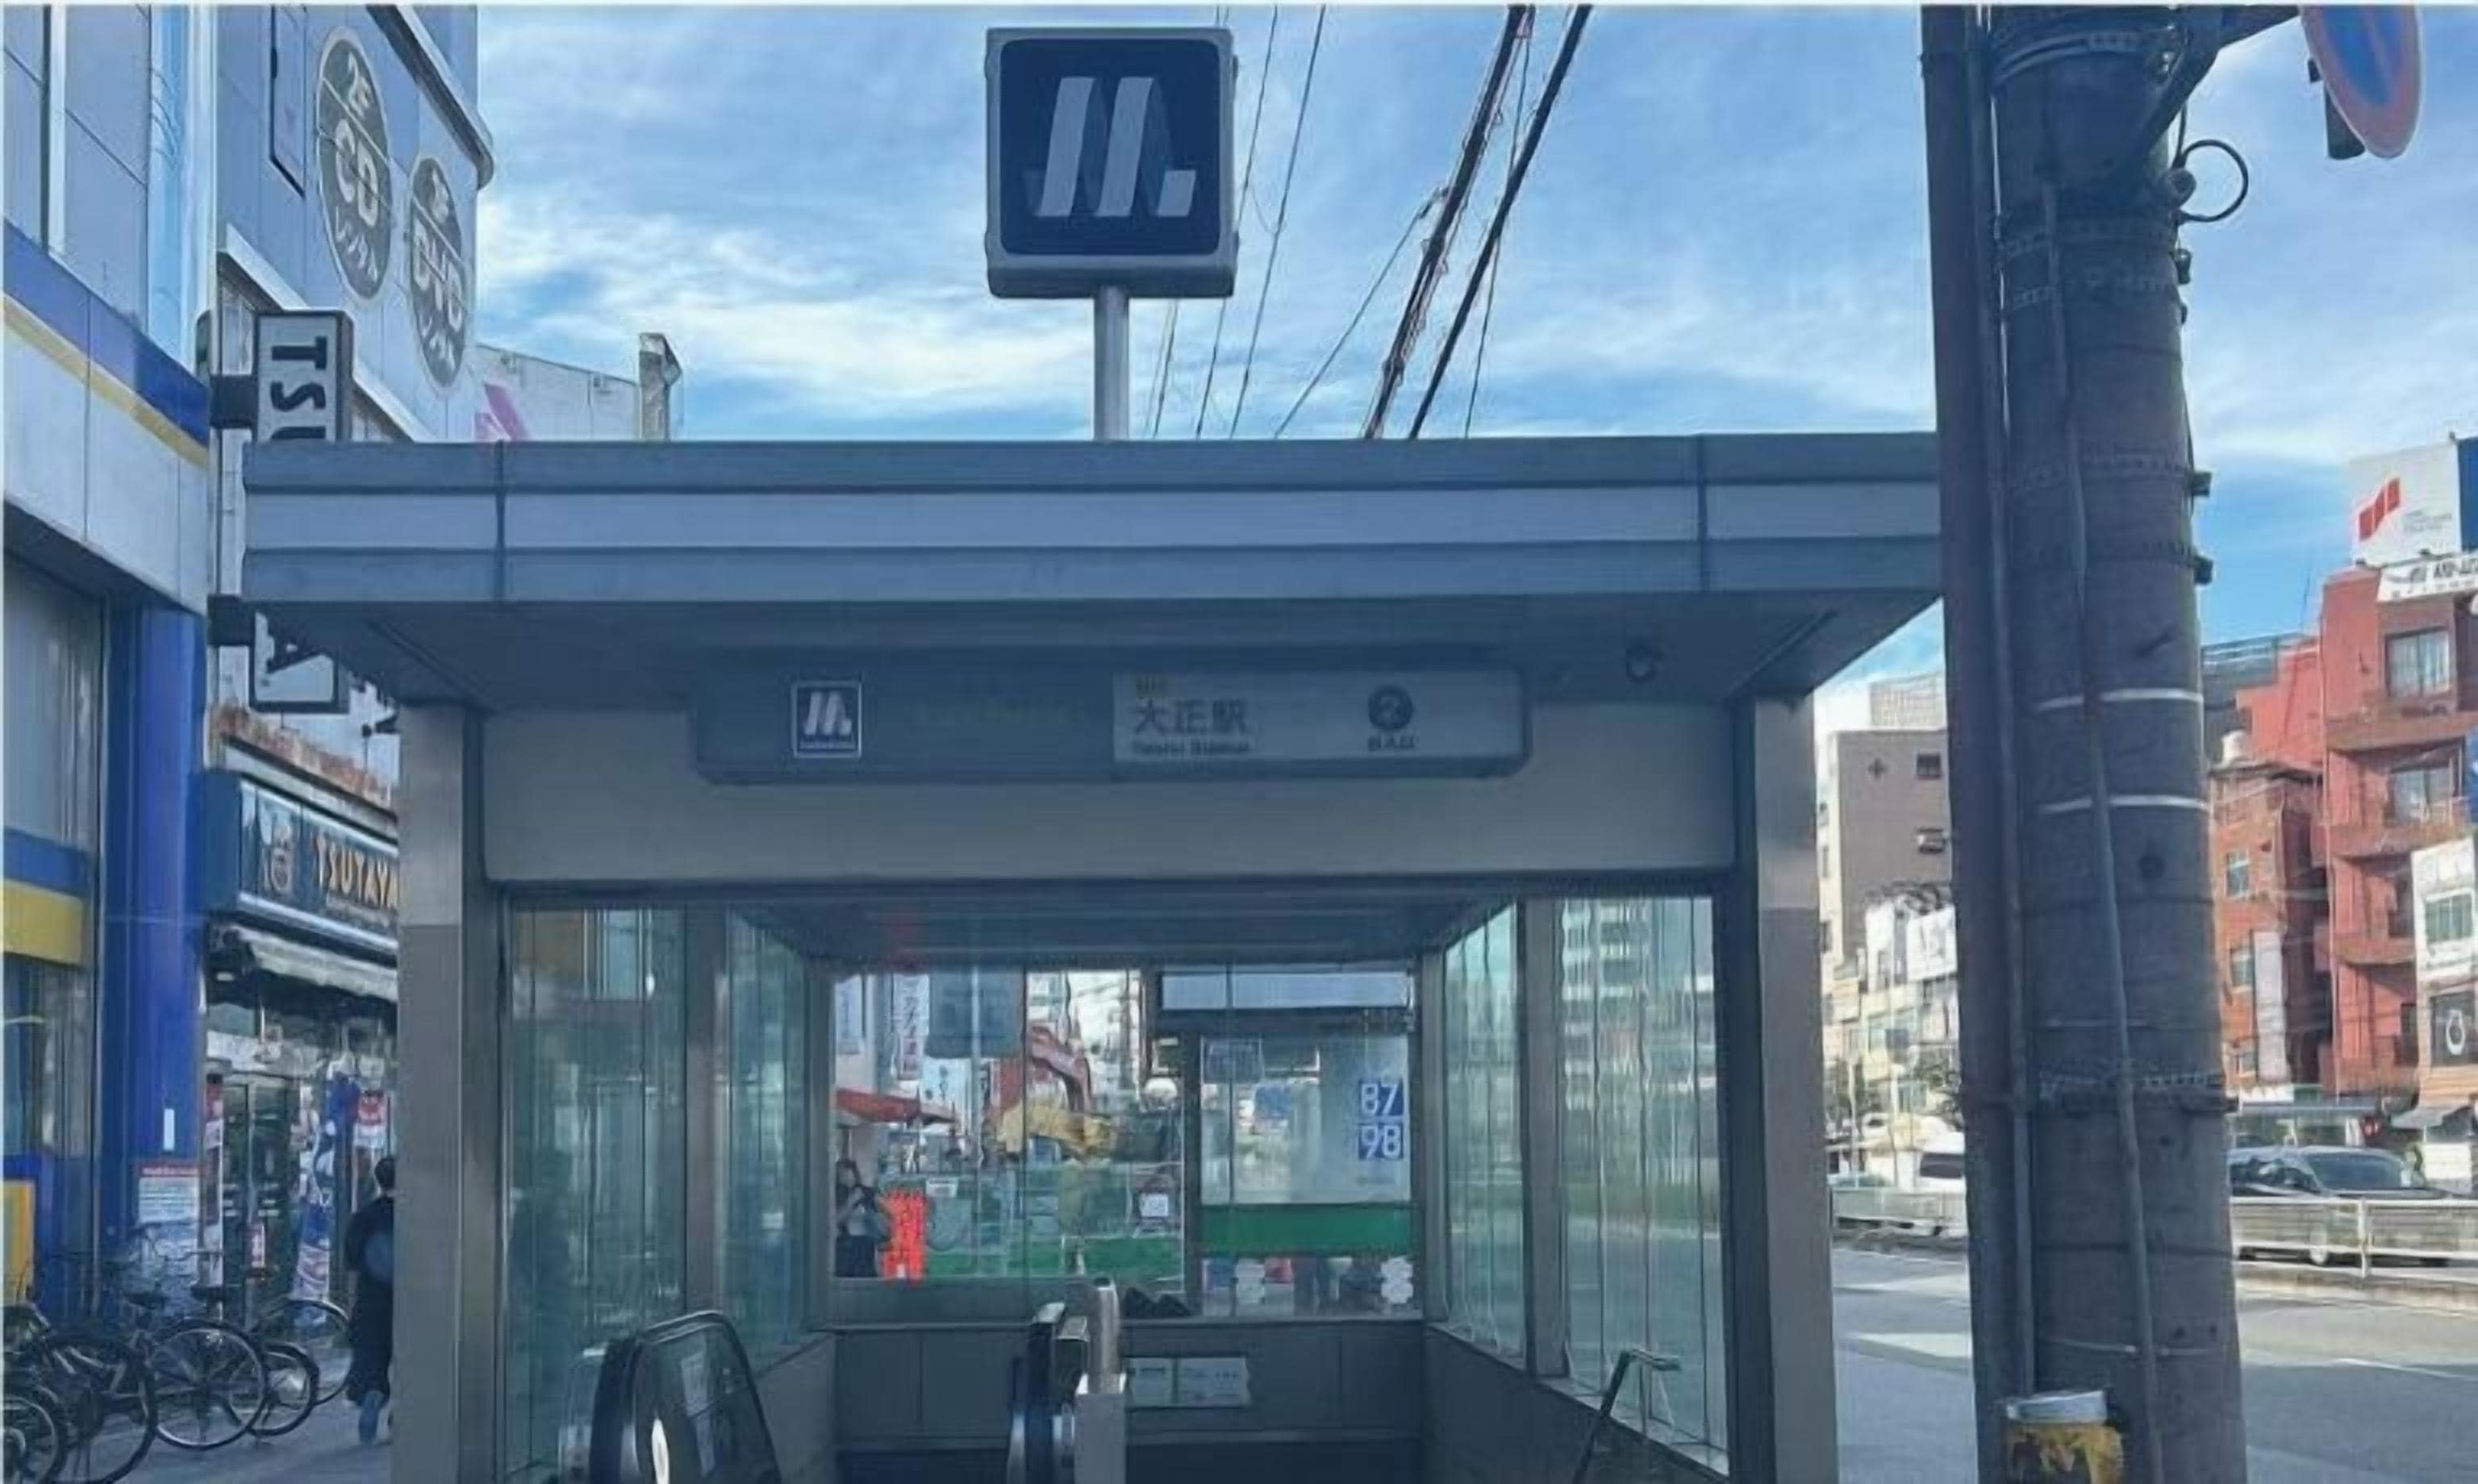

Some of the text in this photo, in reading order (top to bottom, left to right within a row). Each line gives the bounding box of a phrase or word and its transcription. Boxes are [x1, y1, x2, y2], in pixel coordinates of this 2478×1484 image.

[336, 119, 378, 227] CD
[1133, 696, 1247, 734] 大正駅
[1361, 1083, 1399, 1115] 87
[1361, 1125, 1401, 1159] 98
